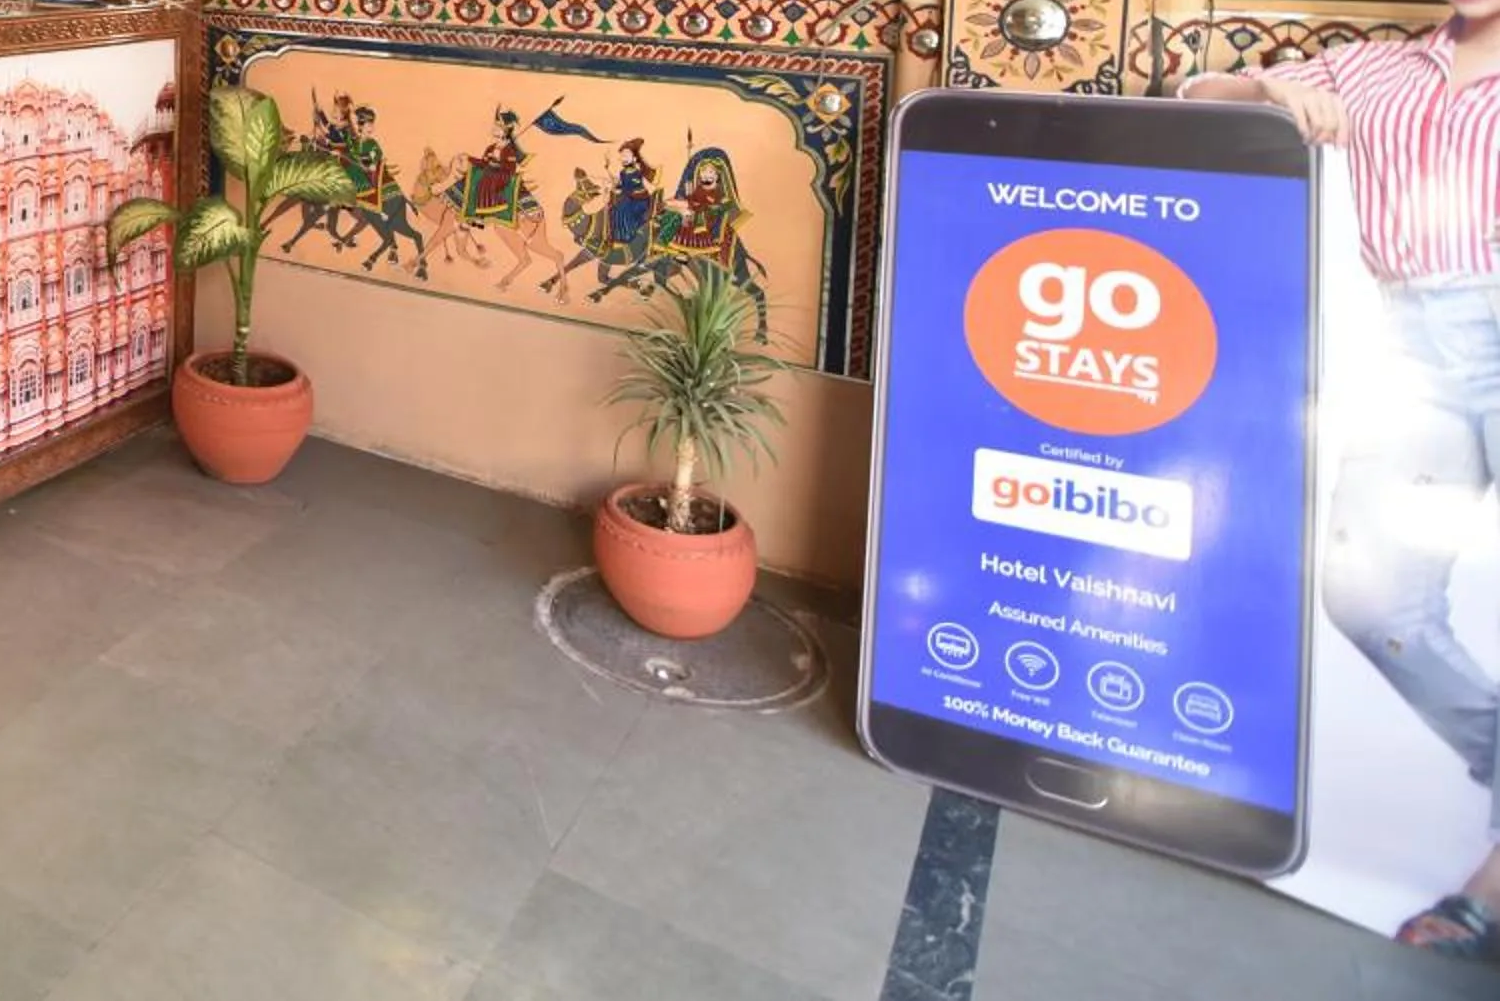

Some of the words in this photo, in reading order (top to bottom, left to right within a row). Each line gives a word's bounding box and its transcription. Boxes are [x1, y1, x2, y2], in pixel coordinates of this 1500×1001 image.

[986, 182, 1148, 218] WELCOME
[1154, 196, 1201, 222] TO
[1018, 261, 1162, 341] go
[1014, 340, 1160, 389] STAYS
[1039, 442, 1102, 464] Certified
[1105, 454, 1124, 470] by
[991, 474, 1171, 529] goibibo
[980, 552, 1046, 585] Hotel
[1053, 568, 1177, 613] Vaishnavi
[988, 601, 1067, 632] Assured
[1069, 622, 1168, 656] Amenities
[943, 694, 989, 719] 100%
[992, 705, 1054, 738] Money
[1057, 722, 1105, 749] Back
[1107, 736, 1210, 777] Guarantee
